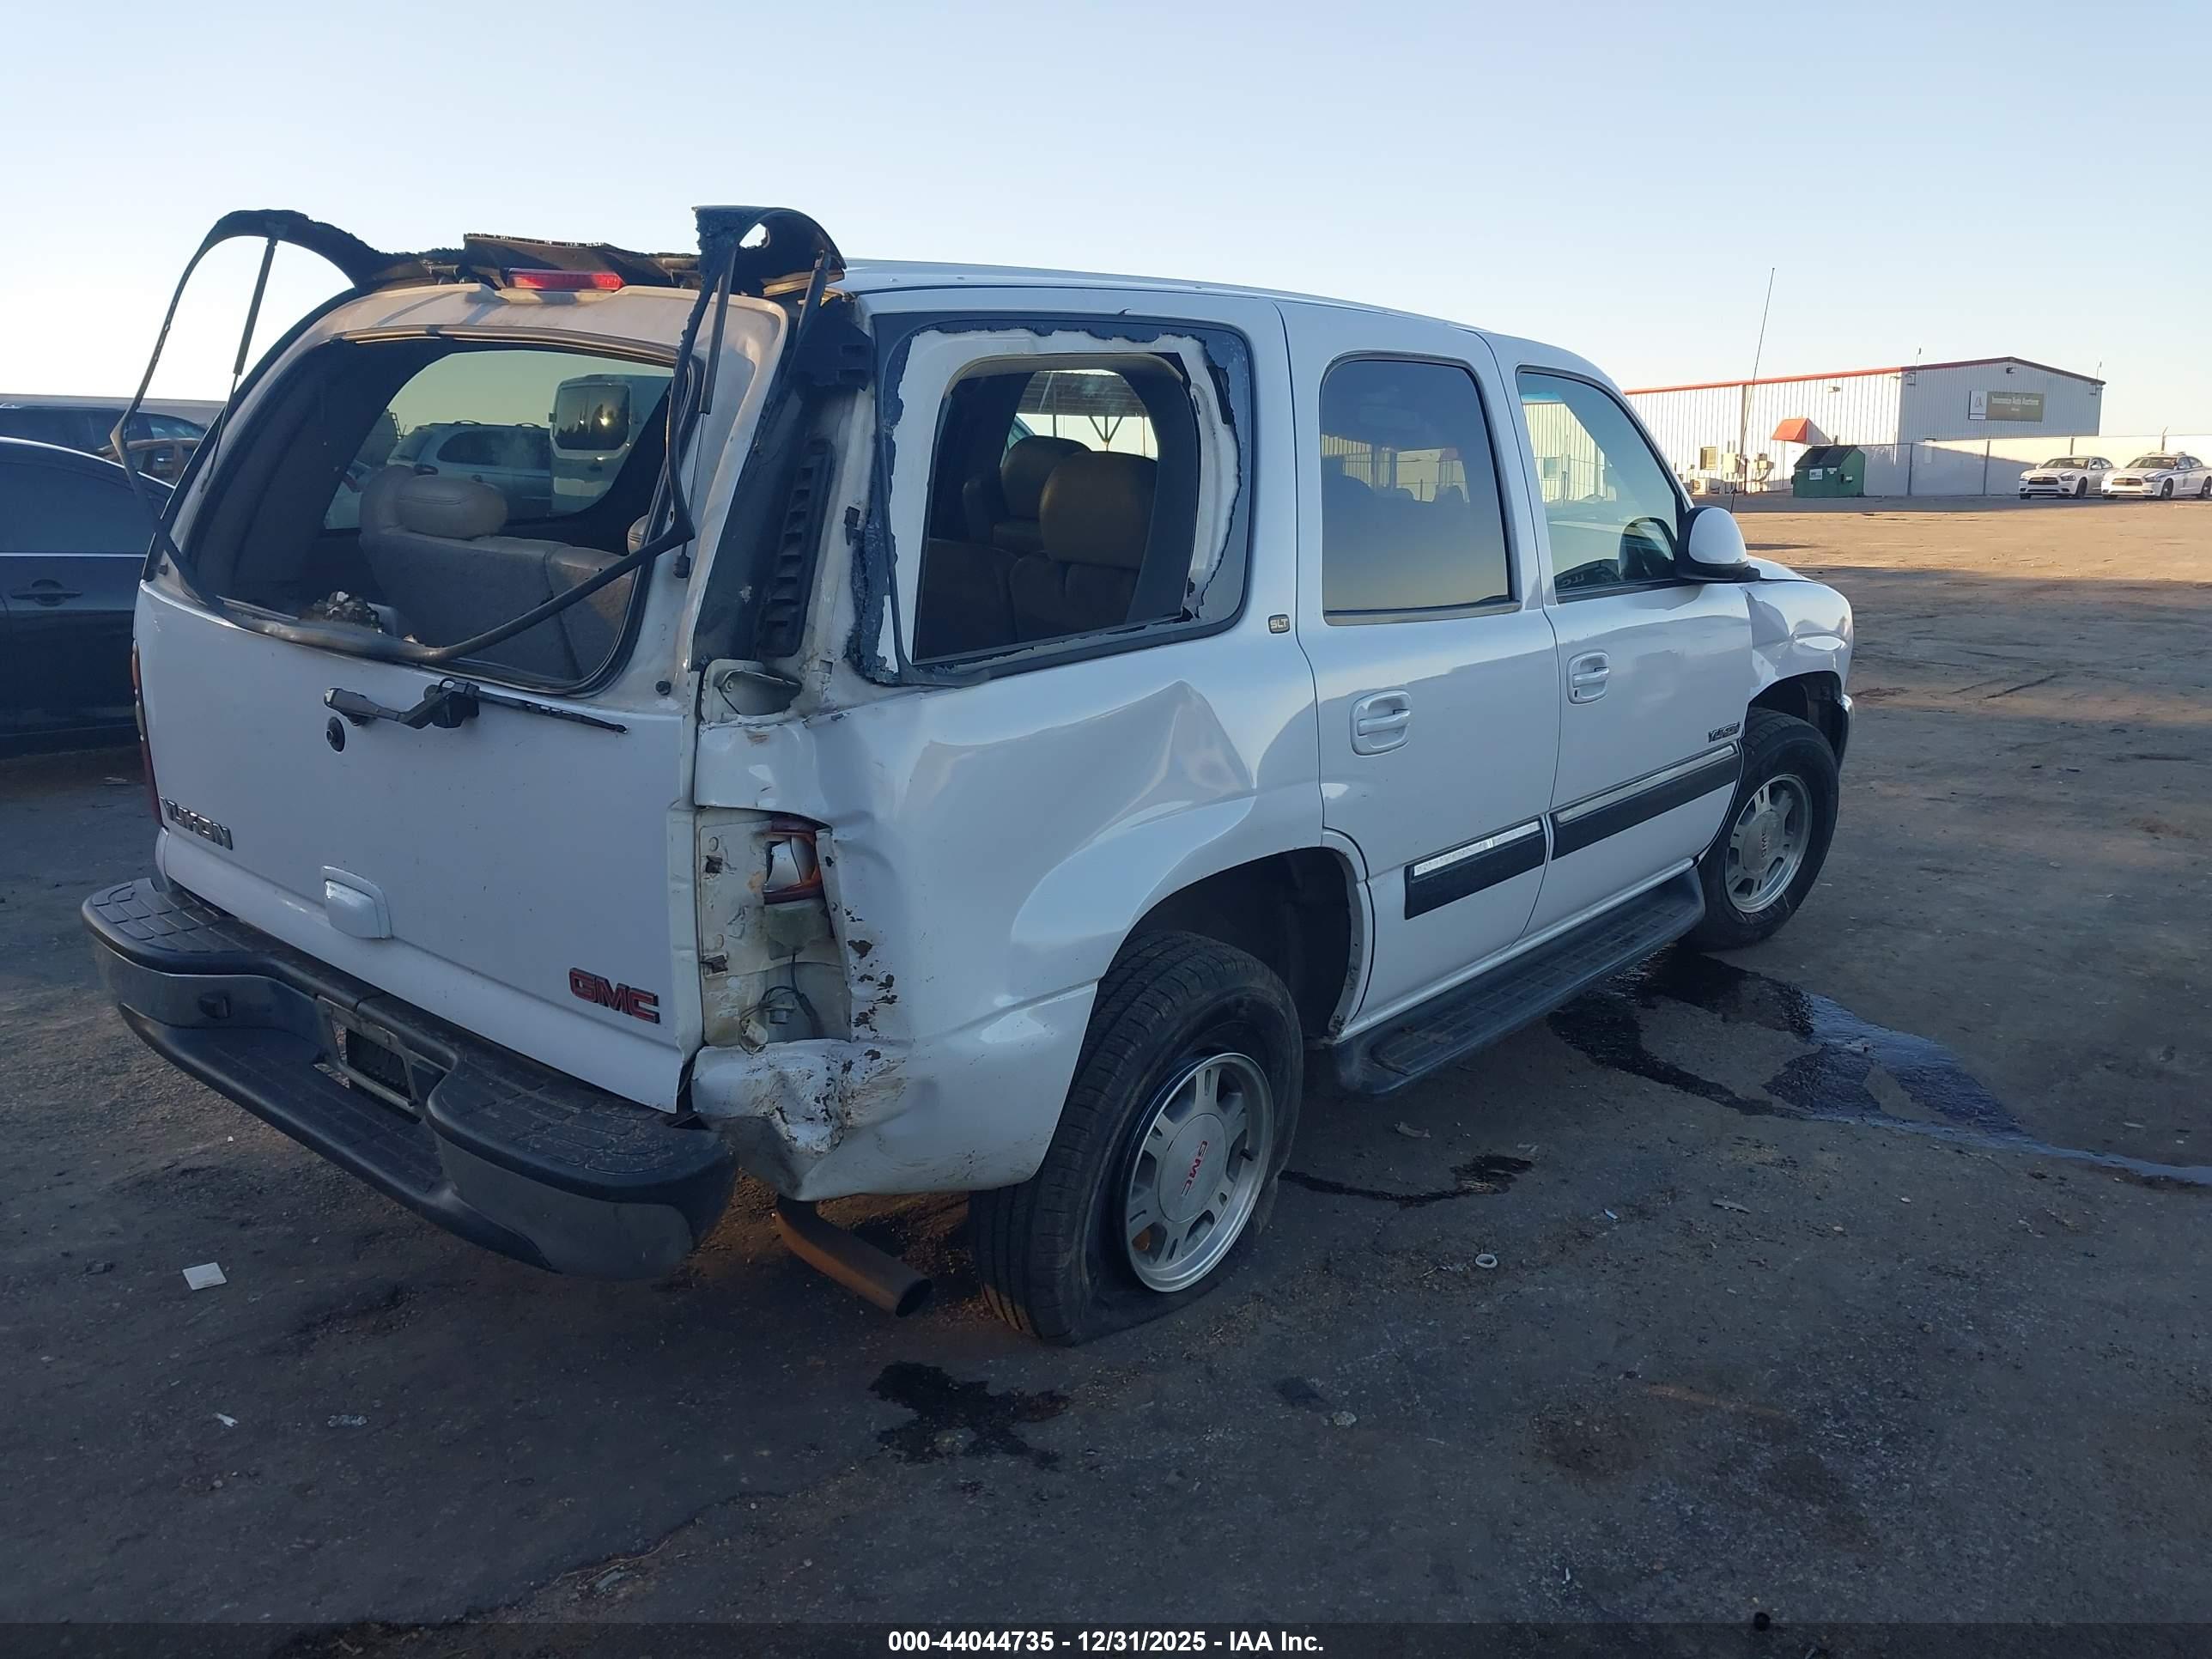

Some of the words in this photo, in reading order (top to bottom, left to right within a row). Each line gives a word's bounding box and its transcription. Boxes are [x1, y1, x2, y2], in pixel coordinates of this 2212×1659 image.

[1270, 618, 1288, 629] SLT
[160, 796, 233, 850] YUKON
[568, 967, 660, 1024] GMC
[1181, 1140, 1208, 1196] GMC
